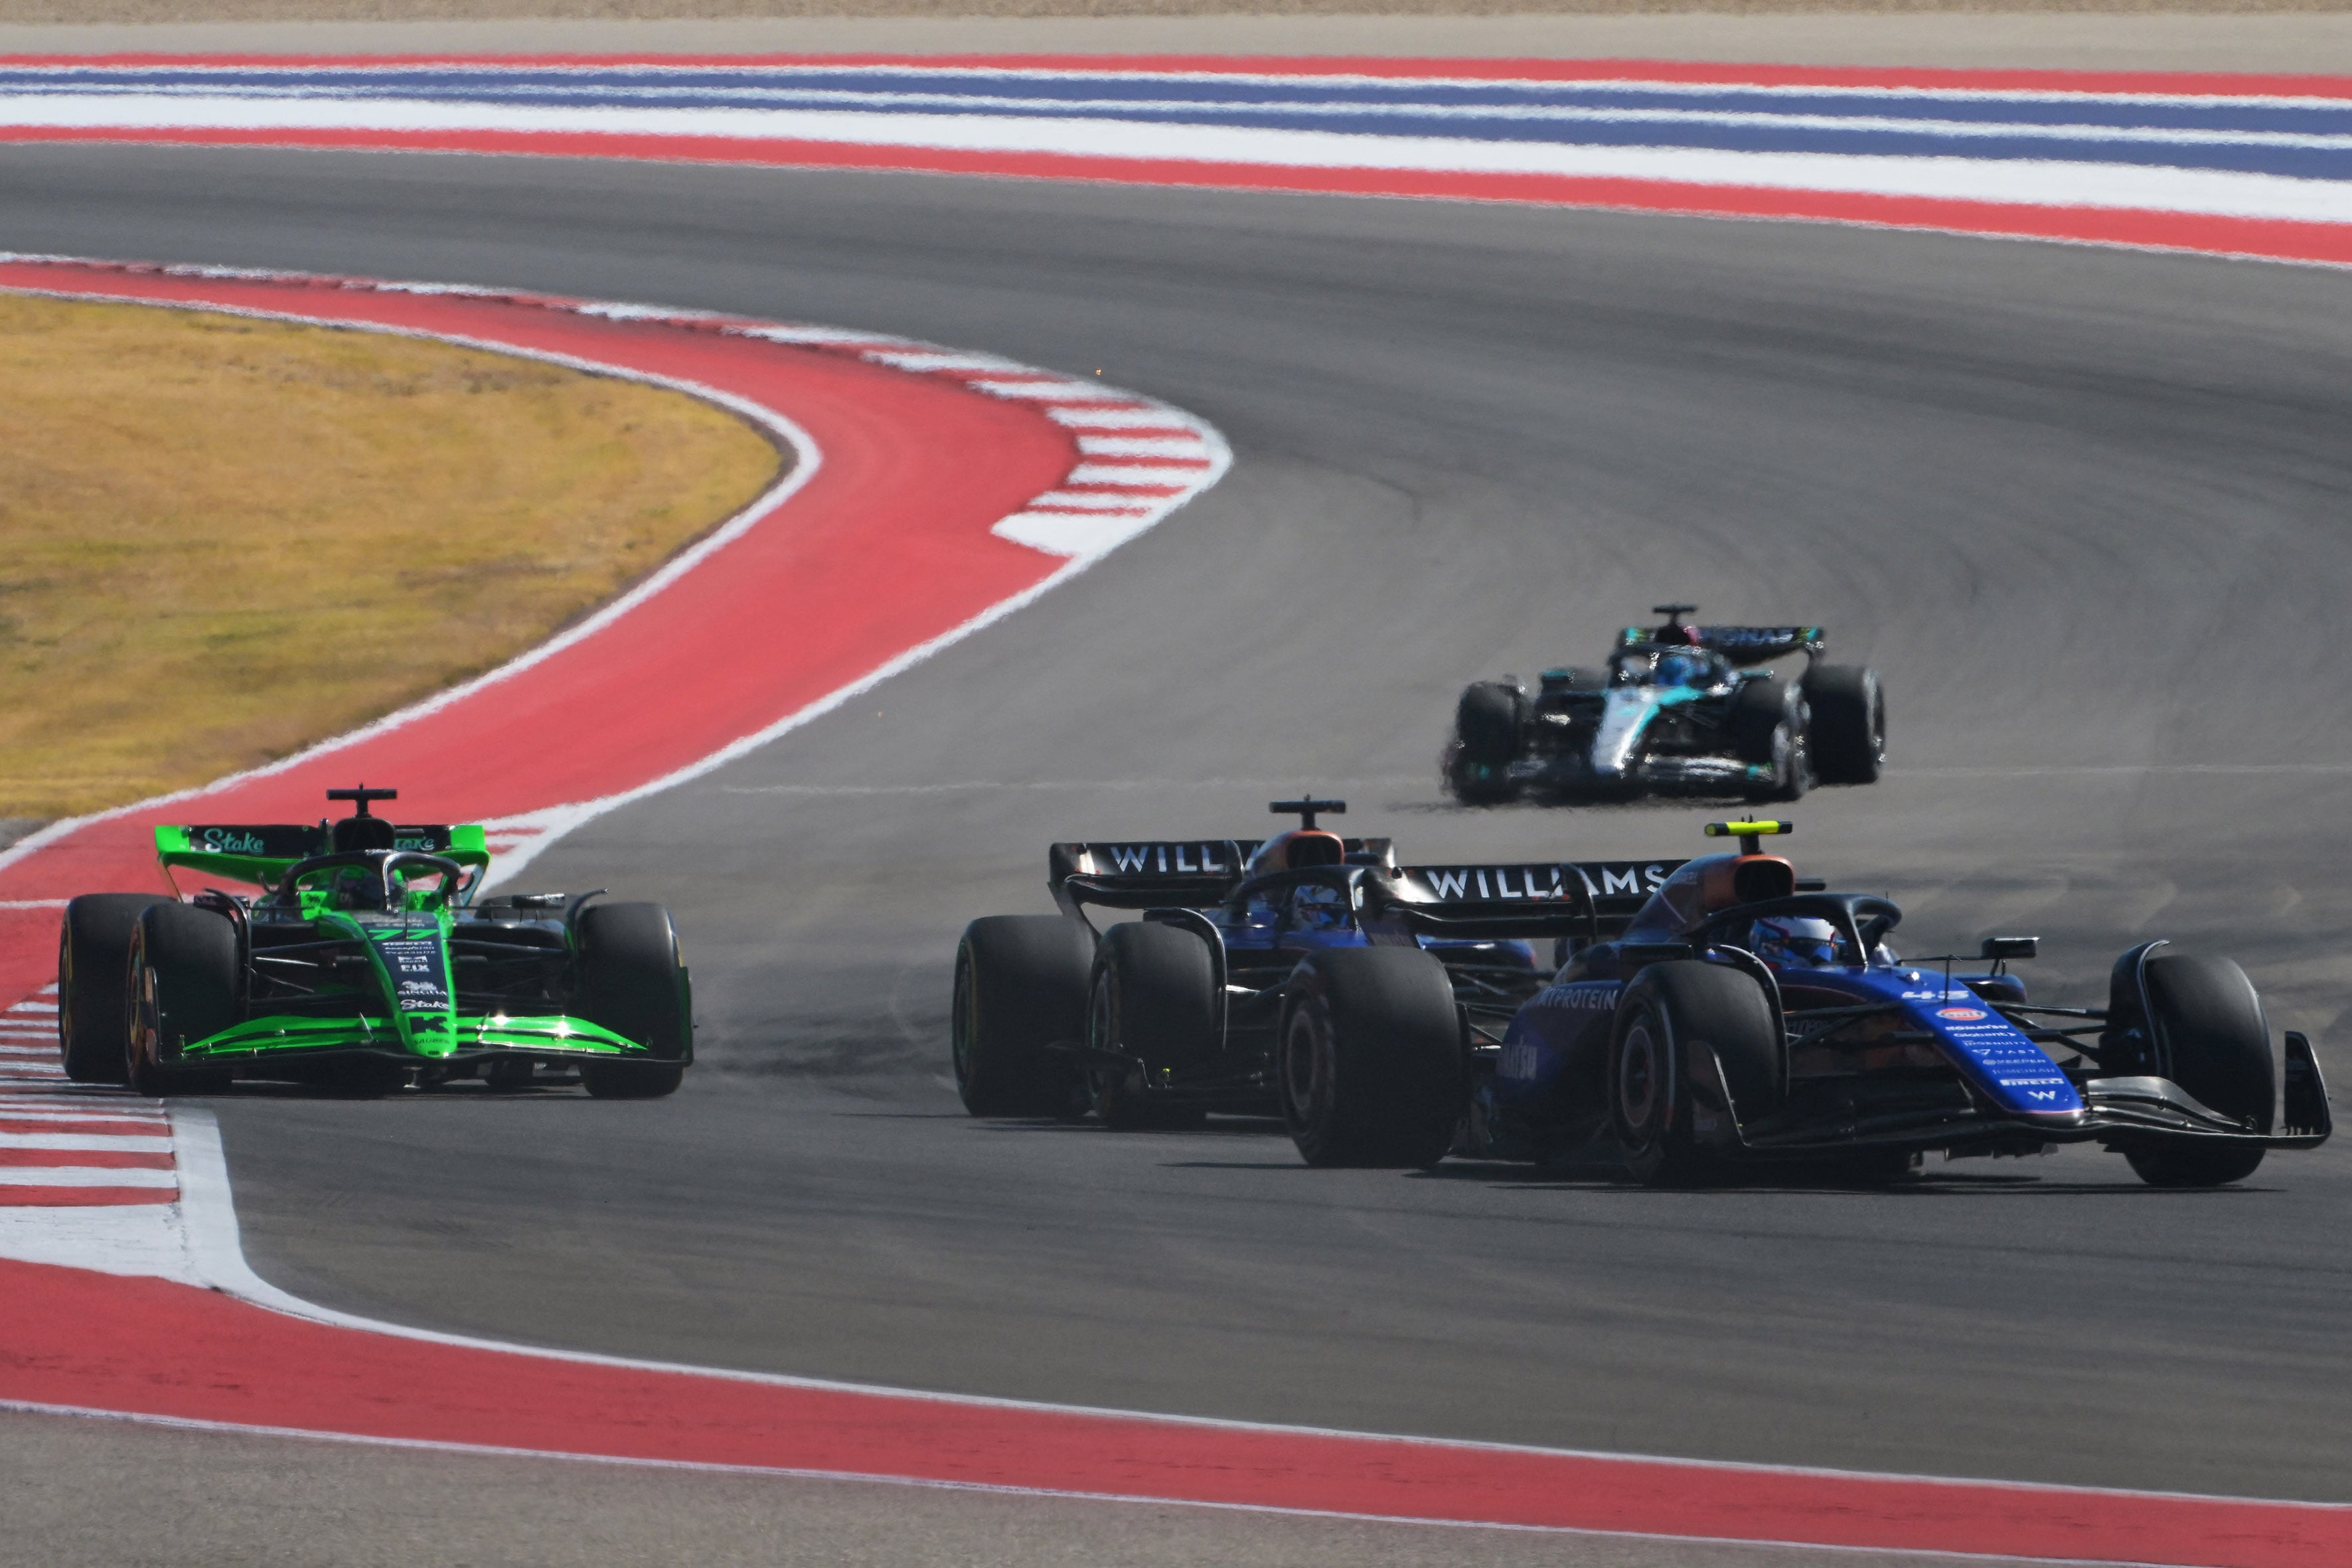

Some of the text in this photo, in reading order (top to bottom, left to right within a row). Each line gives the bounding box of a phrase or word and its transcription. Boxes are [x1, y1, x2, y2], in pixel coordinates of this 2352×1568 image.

[204, 828, 265, 855] Stake
[394, 836, 435, 852] take
[368, 929, 439, 940] 77
[1901, 990, 1969, 1000] 45
[400, 999, 449, 1010] Stake
[2027, 1091, 2056, 1100] W
